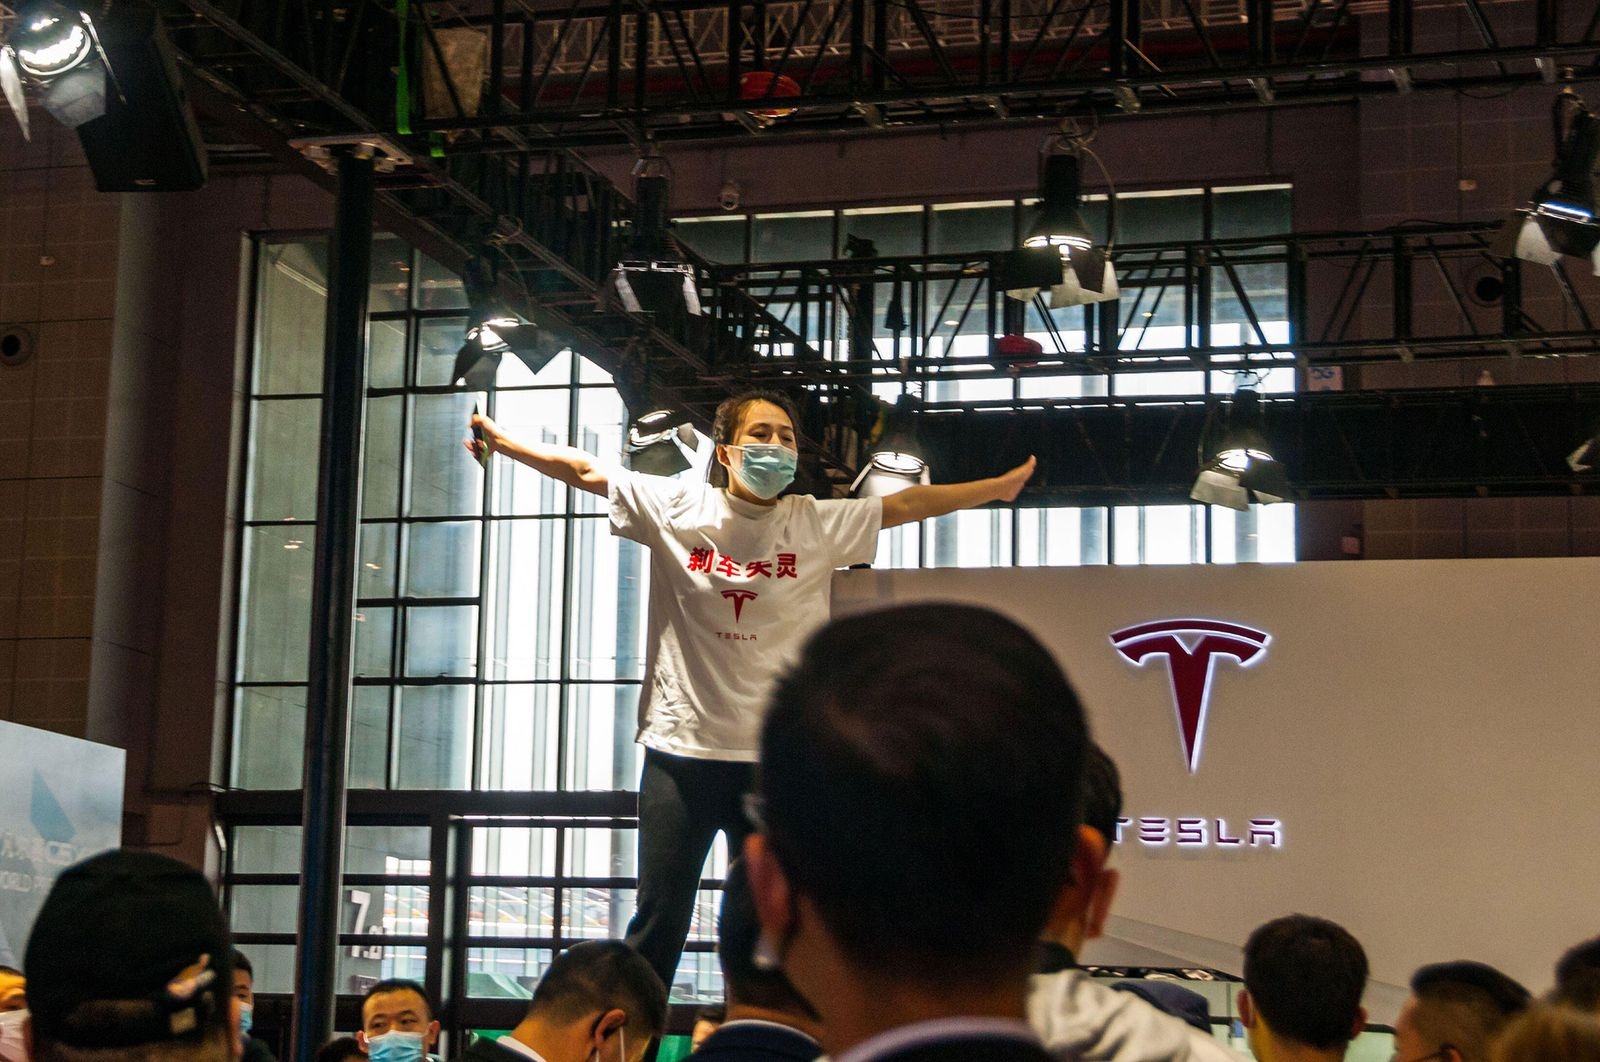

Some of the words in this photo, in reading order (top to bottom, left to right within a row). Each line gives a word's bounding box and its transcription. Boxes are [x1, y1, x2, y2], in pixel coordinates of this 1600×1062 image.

[687, 546, 798, 579] 刹车失灵
[715, 631, 757, 641] TESLA
